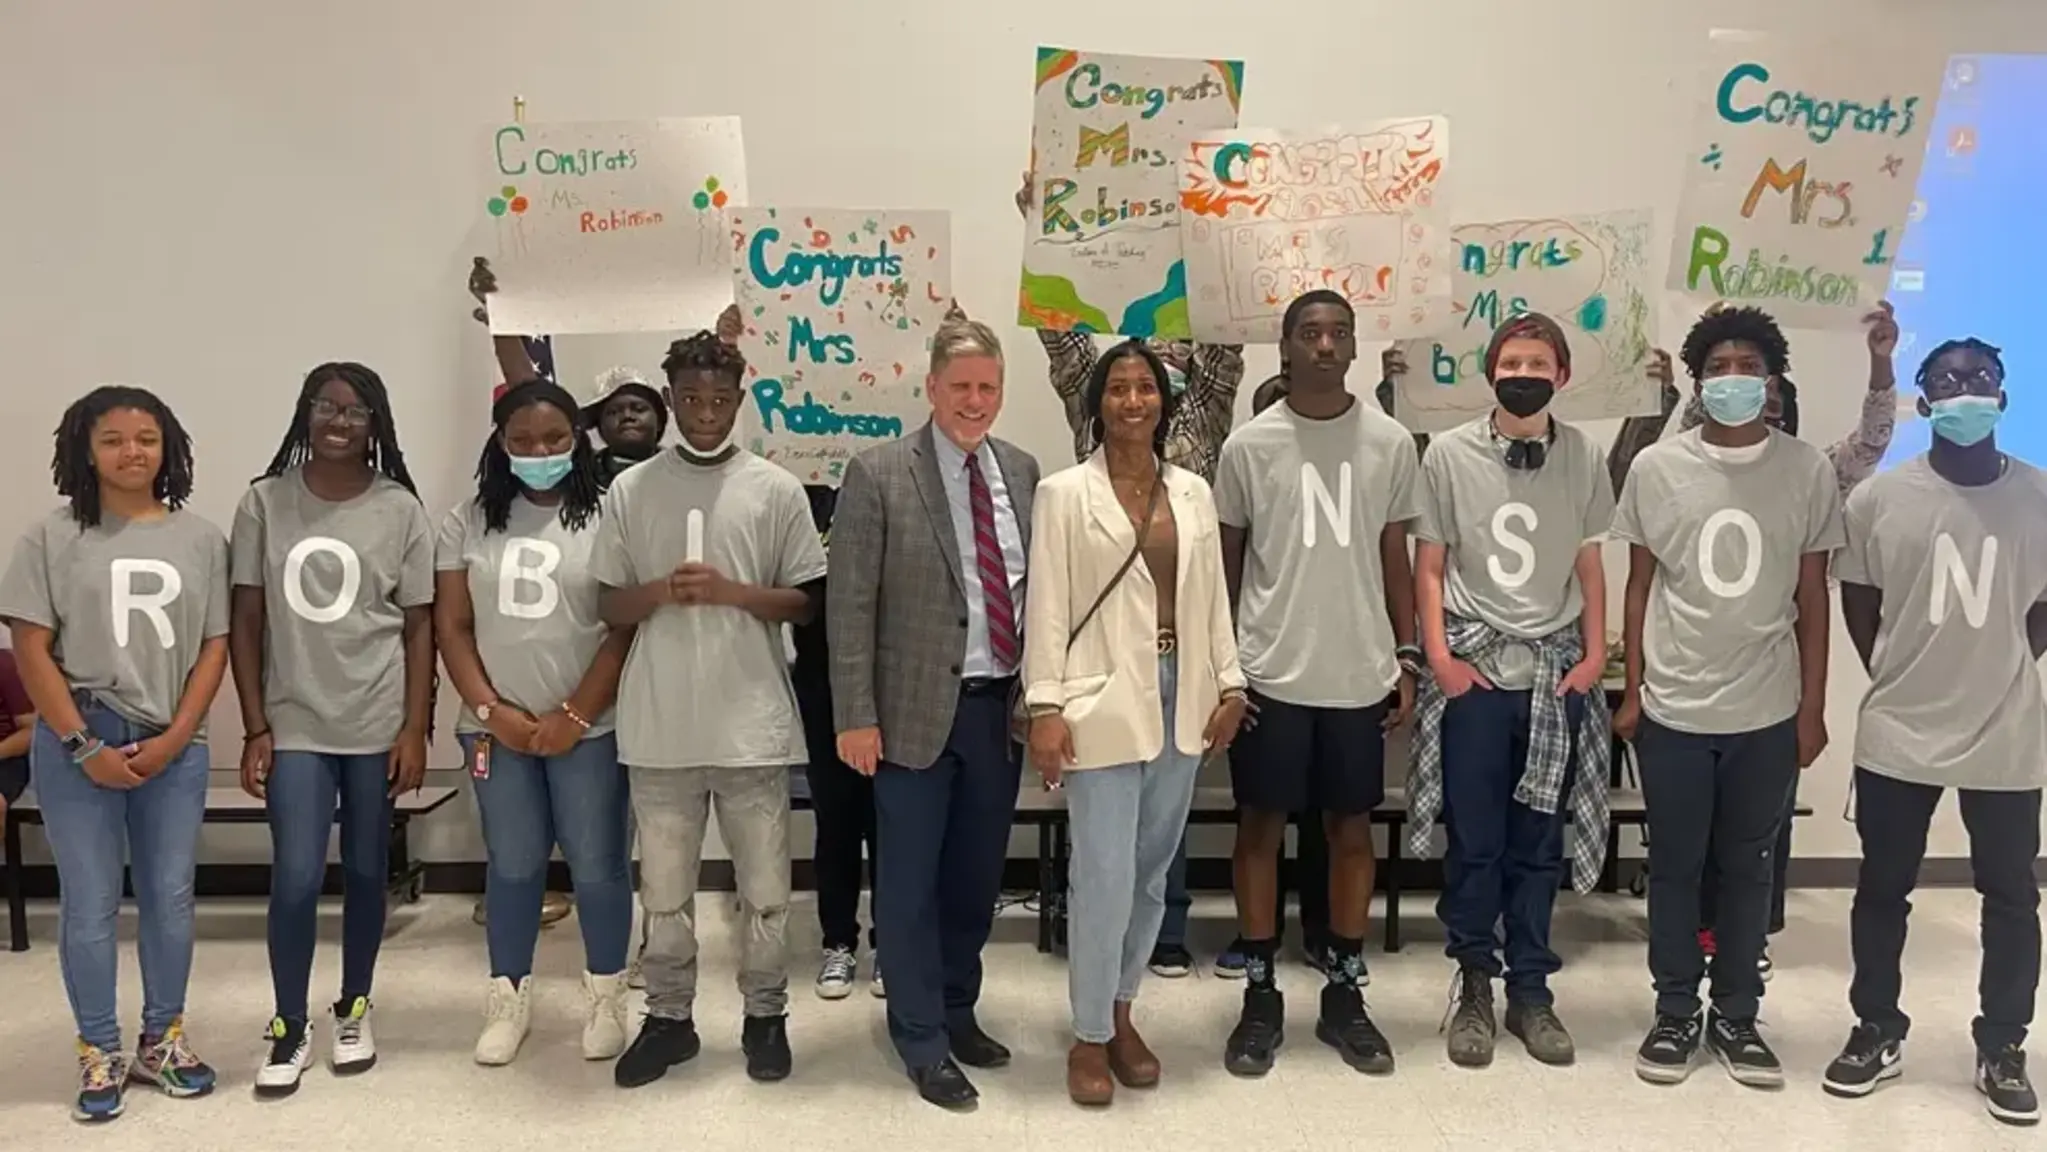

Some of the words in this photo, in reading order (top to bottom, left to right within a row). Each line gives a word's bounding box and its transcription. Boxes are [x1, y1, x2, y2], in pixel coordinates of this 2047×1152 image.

[1066, 63, 1223, 119] Congrats
[1717, 63, 1919, 143] Congrats
[496, 126, 638, 176] Congrats
[580, 211, 663, 232] Robinson
[1042, 178, 1177, 235] Robinso
[749, 227, 904, 306] Congrats
[1461, 238, 1582, 278] ngrats
[1687, 225, 1858, 306] Robinson
[751, 378, 903, 438] Robinson
[1301, 461, 1352, 548] N
[1487, 502, 1538, 587] S
[283, 536, 362, 623] O
[498, 537, 562, 619] B
[1698, 508, 1762, 598] O
[1929, 532, 1998, 629] N
[110, 558, 182, 649] R
